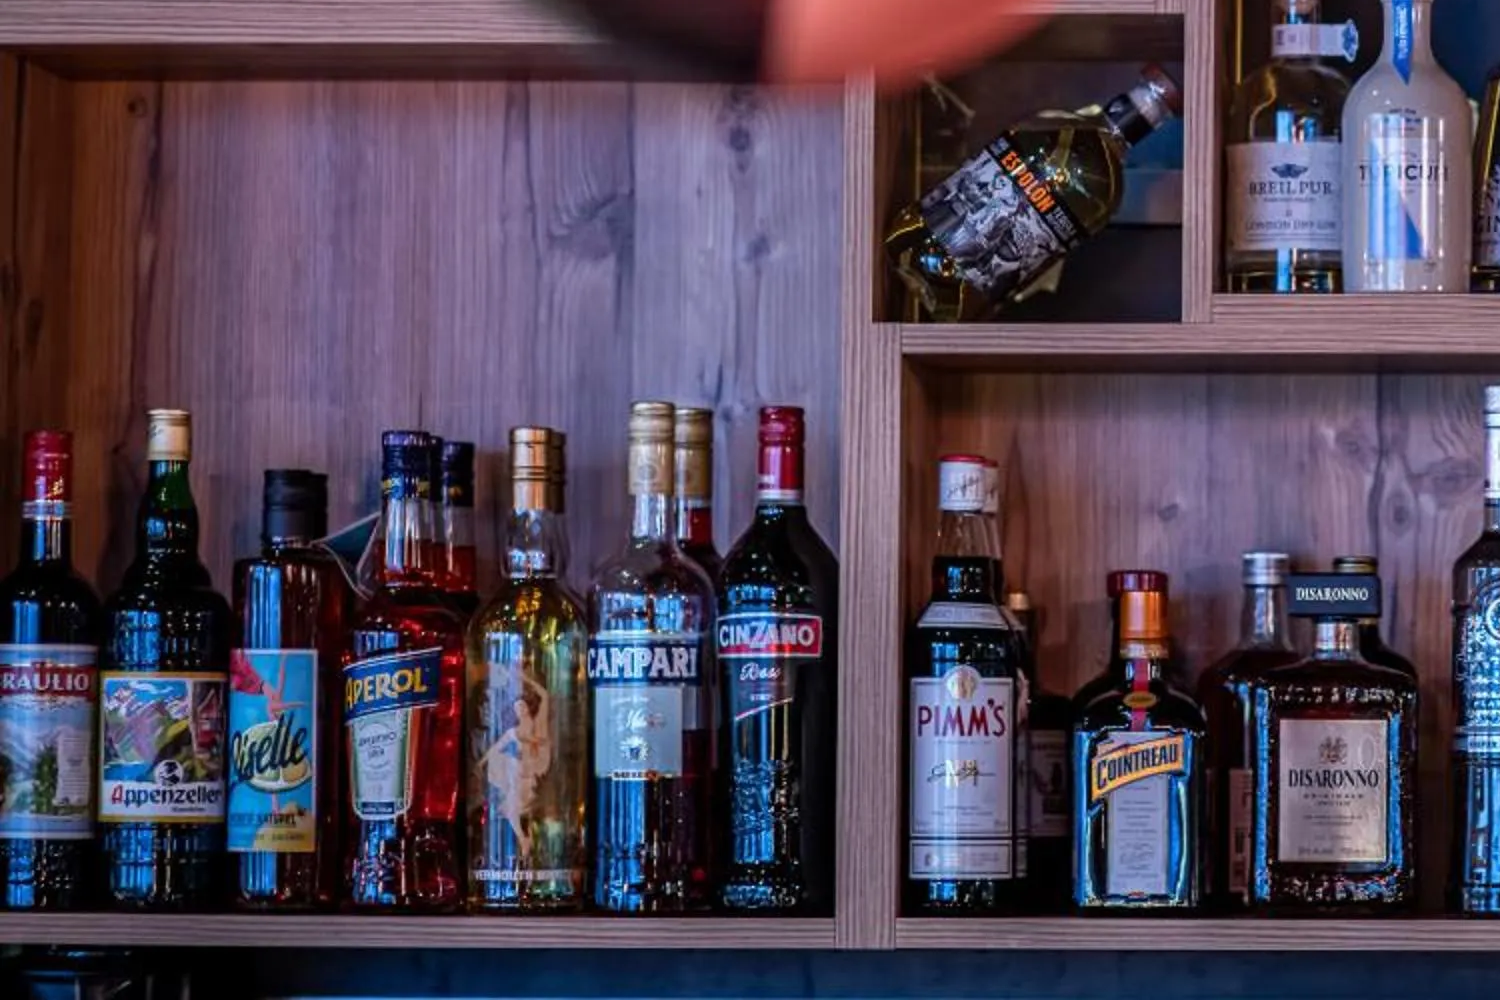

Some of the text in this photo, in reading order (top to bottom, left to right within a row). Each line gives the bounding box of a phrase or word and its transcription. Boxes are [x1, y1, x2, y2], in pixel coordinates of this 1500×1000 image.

[1295, 586, 1369, 604] DISARONNO
[719, 621, 815, 649] CINZANO
[587, 647, 697, 679] CAMPARI
[0, 672, 90, 691] RAULIO
[345, 666, 428, 710] APEROL
[917, 698, 1006, 738] PIMM'S
[1096, 743, 1179, 791] COINTREAU
[1288, 768, 1380, 788] DISARONNO
[111, 784, 222, 809] Appenzeller
